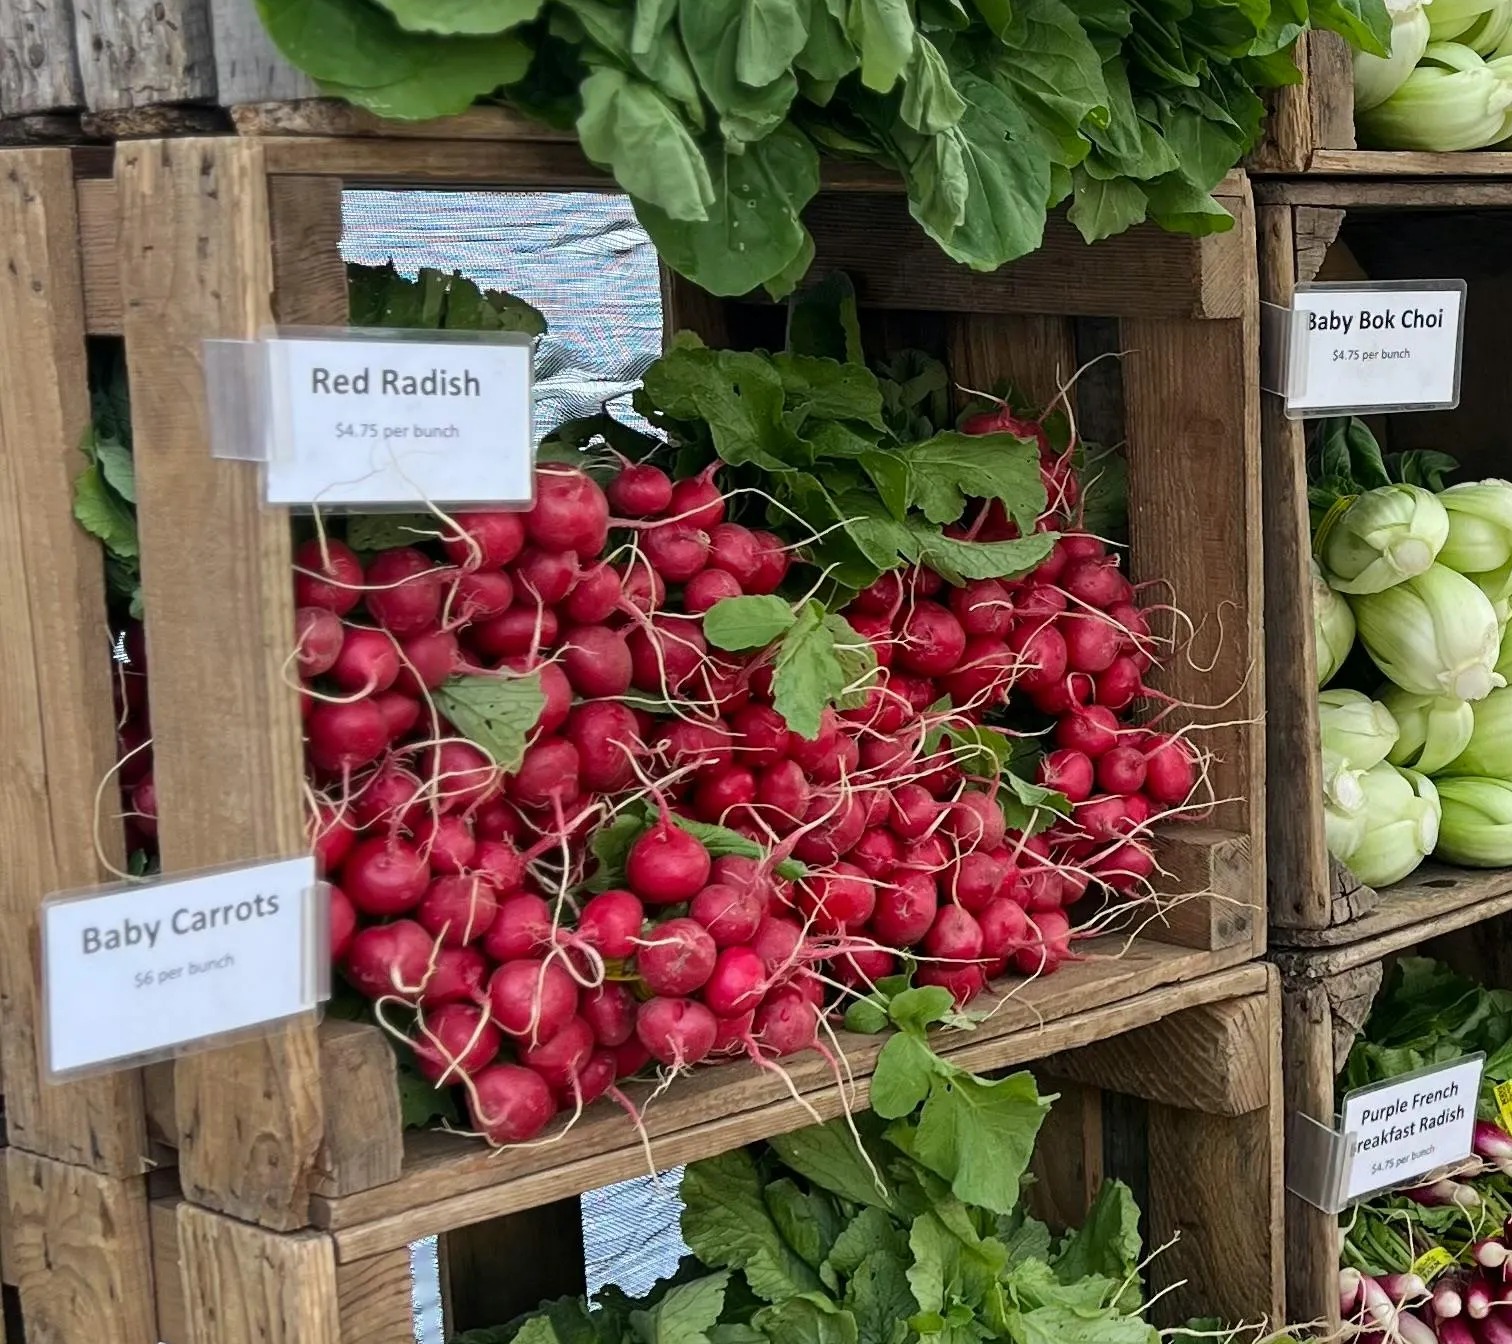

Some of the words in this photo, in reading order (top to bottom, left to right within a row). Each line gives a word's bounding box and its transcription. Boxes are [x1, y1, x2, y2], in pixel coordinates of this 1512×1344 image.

[1309, 309, 1354, 335] Baby
[1359, 310, 1395, 330] Bok
[1401, 308, 1444, 329] Choi
[1332, 349, 1359, 362] $4.75
[1362, 350, 1379, 363] per
[1381, 348, 1411, 360] bunch
[311, 367, 369, 395] Red
[382, 368, 481, 397] Radish
[335, 422, 378, 439] $4.75
[383, 425, 409, 441] per
[413, 423, 459, 438] bunch
[82, 918, 161, 955] Baby
[171, 893, 280, 936] Carrots
[134, 969, 154, 989] $6
[158, 966, 183, 985] per
[188, 953, 235, 976] bunch
[1361, 1098, 1408, 1126] Purple
[1412, 1081, 1459, 1110] French
[1419, 1104, 1465, 1133] Radish
[1371, 1158, 1394, 1175] $4.75
[1396, 1154, 1410, 1168] per
[1412, 1144, 1435, 1160] bunch
